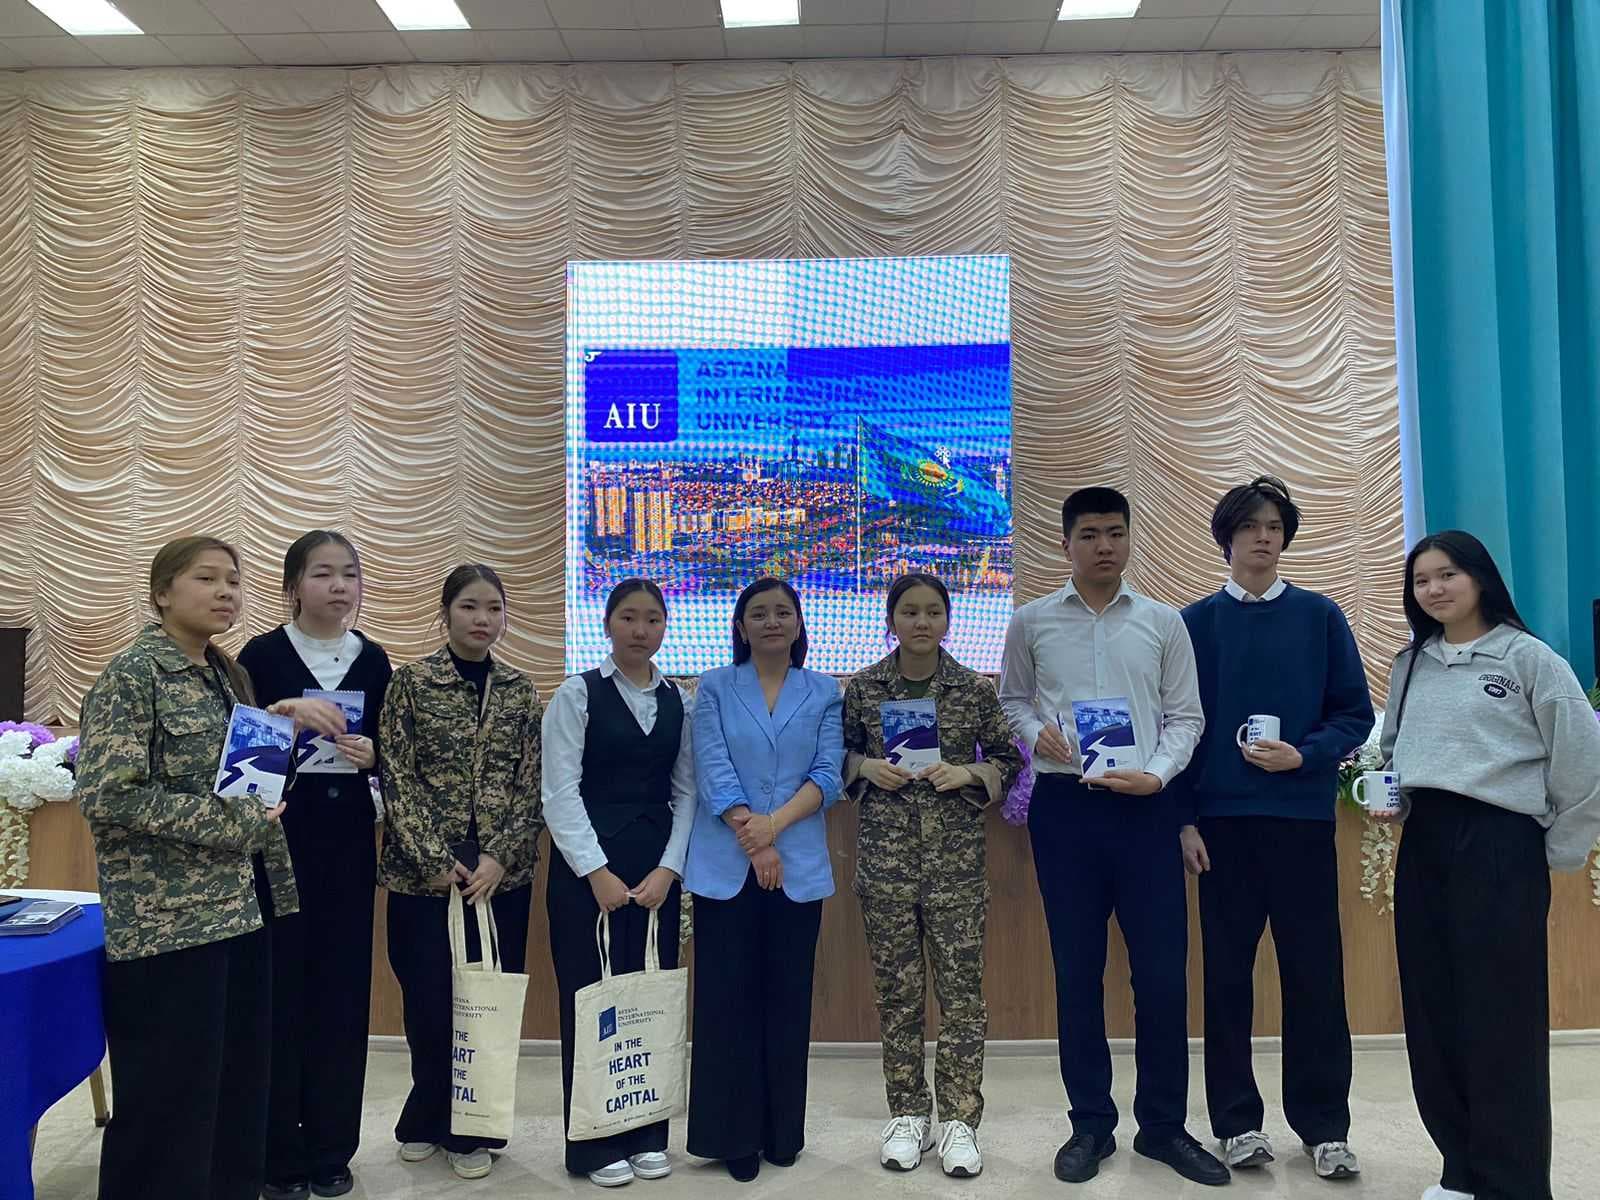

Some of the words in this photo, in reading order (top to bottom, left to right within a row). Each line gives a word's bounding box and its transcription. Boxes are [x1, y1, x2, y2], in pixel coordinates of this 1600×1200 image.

[696, 361, 788, 379] ASTANA
[602, 402, 661, 429] AIU
[696, 412, 833, 431] UNIVERSITY
[1478, 674, 1520, 694] ORIGINALS
[455, 1030, 469, 1042] THE
[614, 1041, 622, 1052] IN
[625, 1037, 643, 1049] THE
[609, 1052, 651, 1075] HEART
[454, 1068, 467, 1080] THE
[616, 1078, 625, 1090] OF
[627, 1074, 646, 1086] THE
[606, 1088, 660, 1113] CAPITAL
